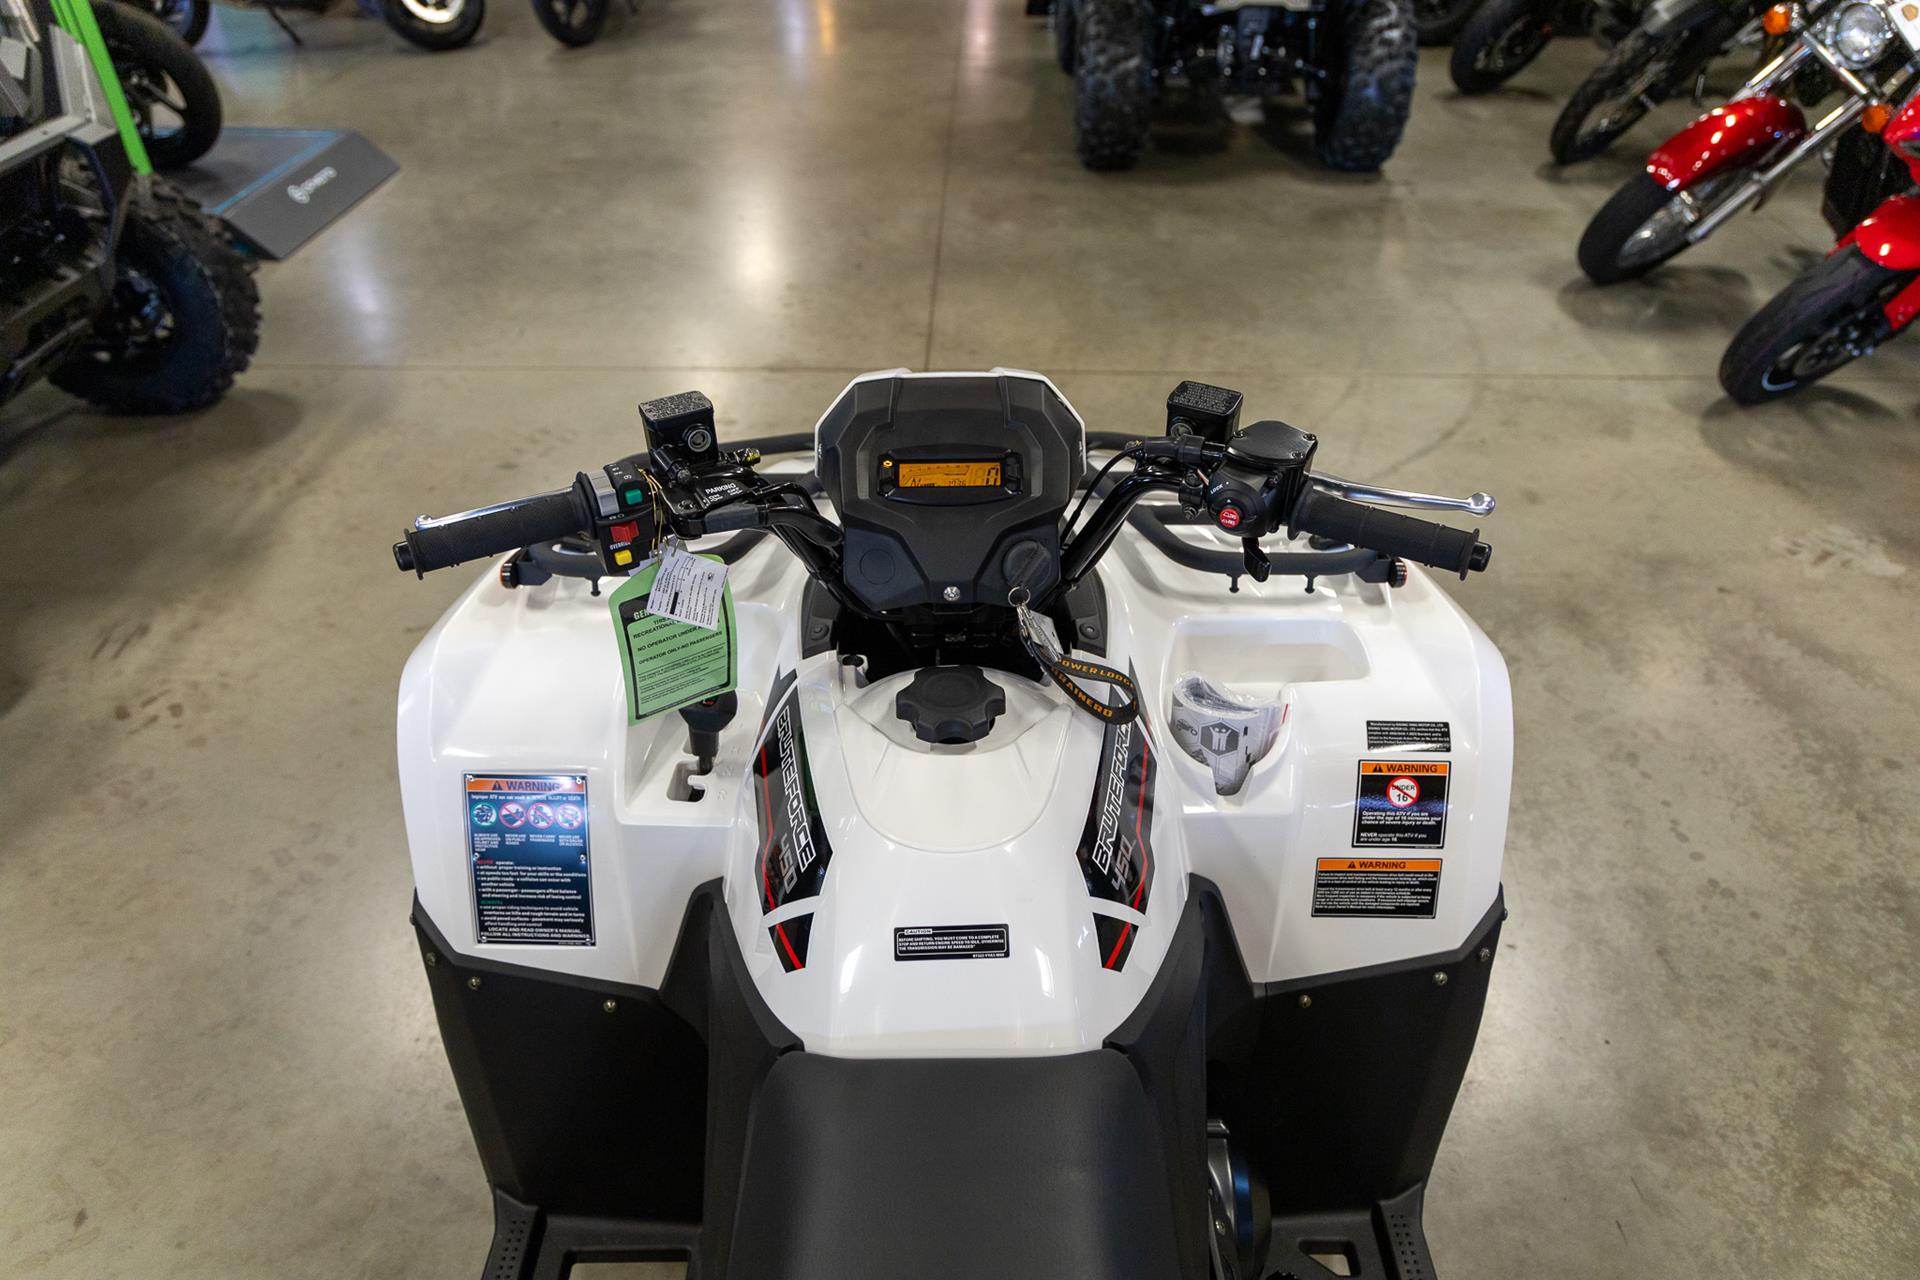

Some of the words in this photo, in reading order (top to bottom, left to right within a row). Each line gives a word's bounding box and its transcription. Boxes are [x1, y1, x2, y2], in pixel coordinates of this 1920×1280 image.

[705, 483, 737, 494] PARKING
[1210, 484, 1223, 494] LOCK
[647, 633, 677, 649] OPERATOR
[638, 651, 667, 665] OPERATOR
[1061, 659, 1098, 674] OWER
[1386, 763, 1438, 773] WARNING
[776, 704, 816, 873] BRUTEFORCE
[1396, 793, 1408, 802] 16
[780, 832, 798, 895] 450
[1111, 834, 1134, 892] 450
[1359, 861, 1406, 869] WARNING
